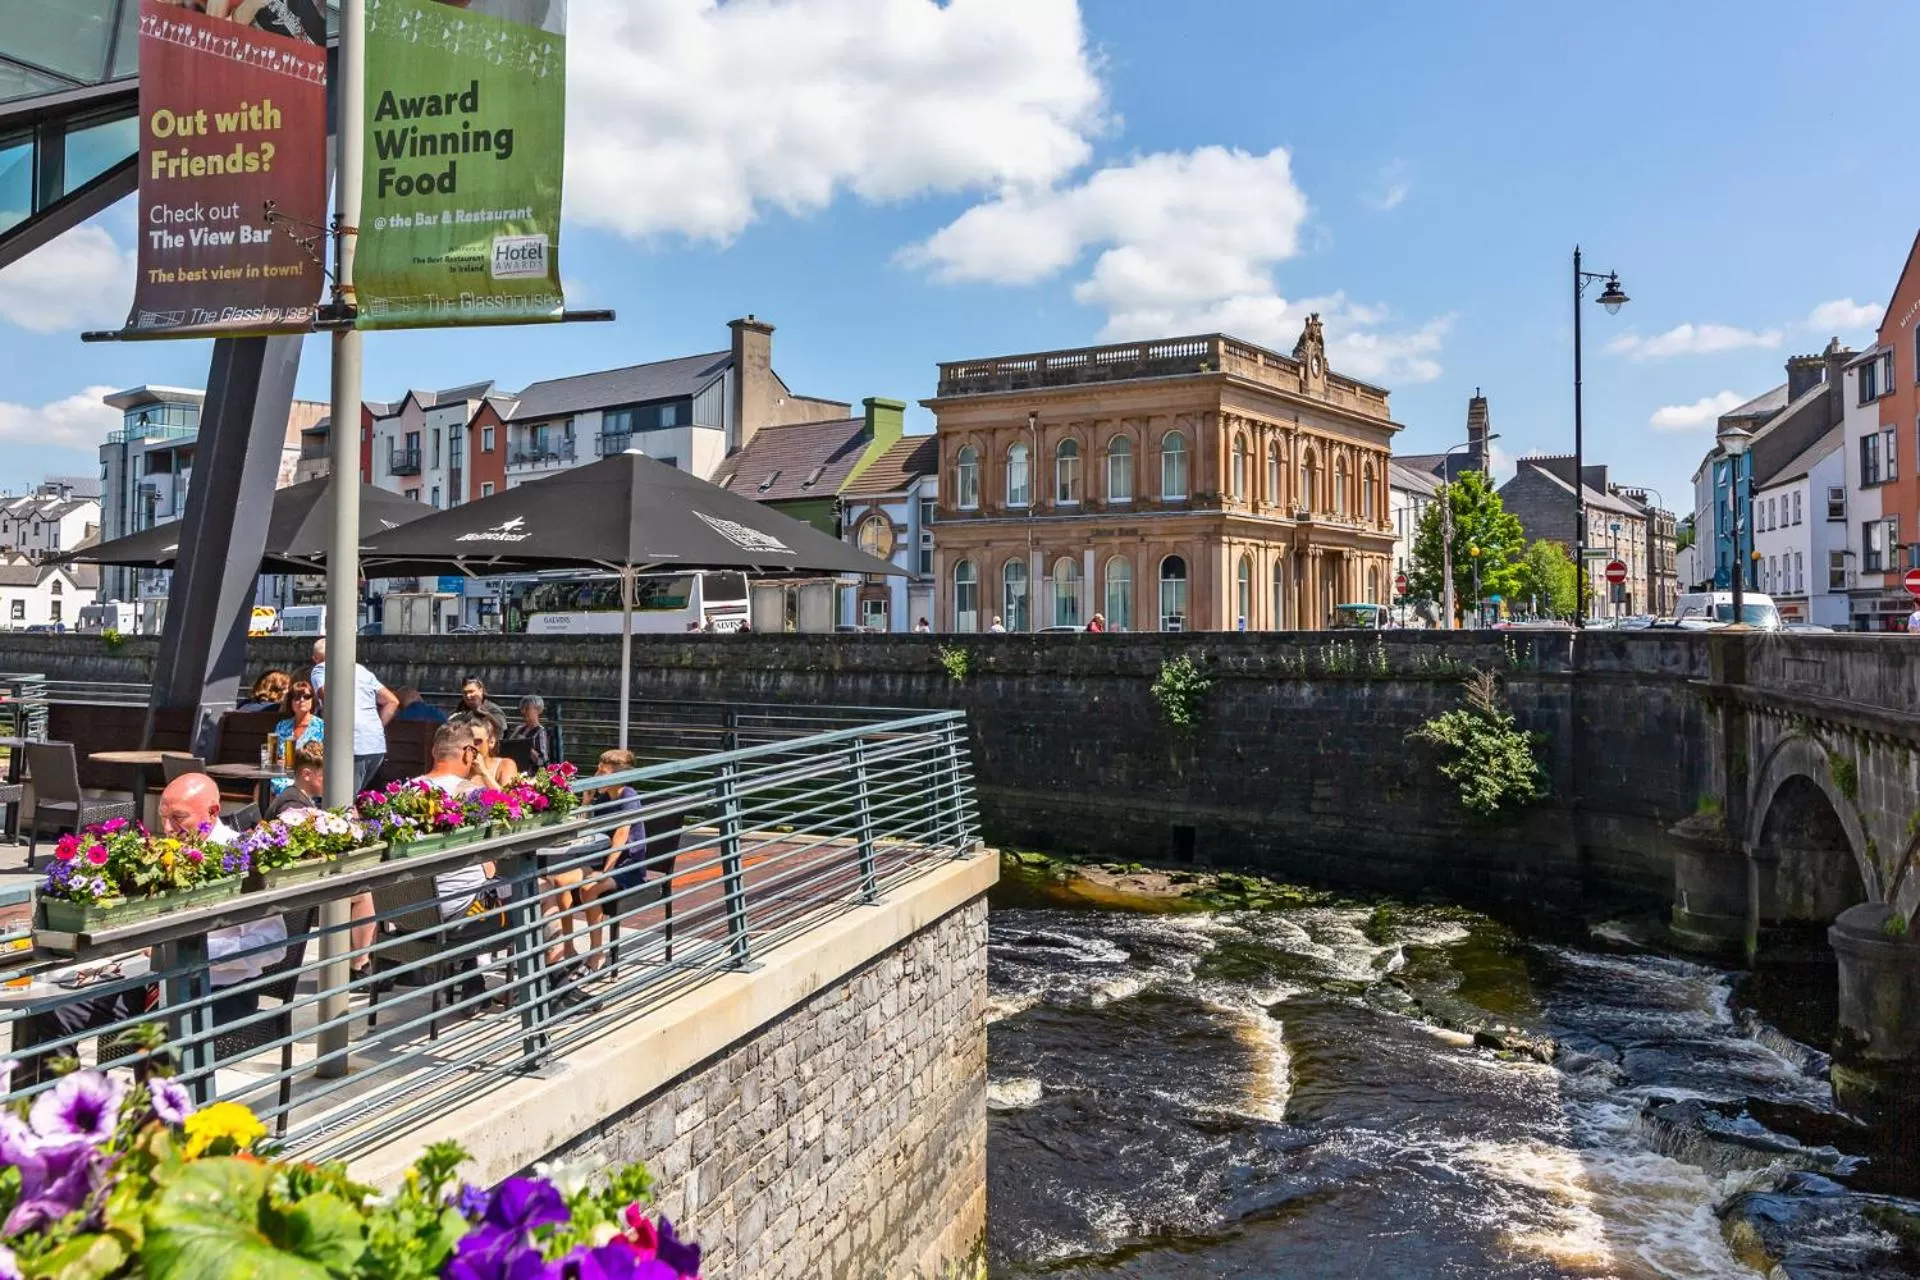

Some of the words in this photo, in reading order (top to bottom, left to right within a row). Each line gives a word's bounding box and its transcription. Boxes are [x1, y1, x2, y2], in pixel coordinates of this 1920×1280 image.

[374, 80, 479, 122] Award
[151, 109, 208, 138] Out
[215, 99, 282, 133] with
[374, 121, 514, 161] Winning
[151, 142, 276, 180] Friends?
[378, 160, 456, 199] Food
[150, 202, 204, 224] Check
[209, 203, 240, 220] out
[374, 216, 387, 230] @
[390, 214, 412, 228] the
[415, 211, 439, 226] Bar
[441, 211, 452, 224] &
[455, 207, 533, 223] Restaurant
[149, 230, 185, 249] The
[189, 227, 235, 246] View
[240, 225, 272, 244] Bar
[412, 256, 426, 264] The
[445, 255, 485, 264] Restaurant
[495, 242, 544, 261] Hotel
[148, 268, 176, 284] The
[177, 267, 208, 282] best
[211, 265, 243, 280] view
[247, 264, 260, 278] in
[264, 261, 304, 276] town!
[495, 260, 544, 271] AWARDS
[190, 307, 218, 324] The
[219, 305, 310, 322] Glasshouse
[423, 293, 456, 313] The
